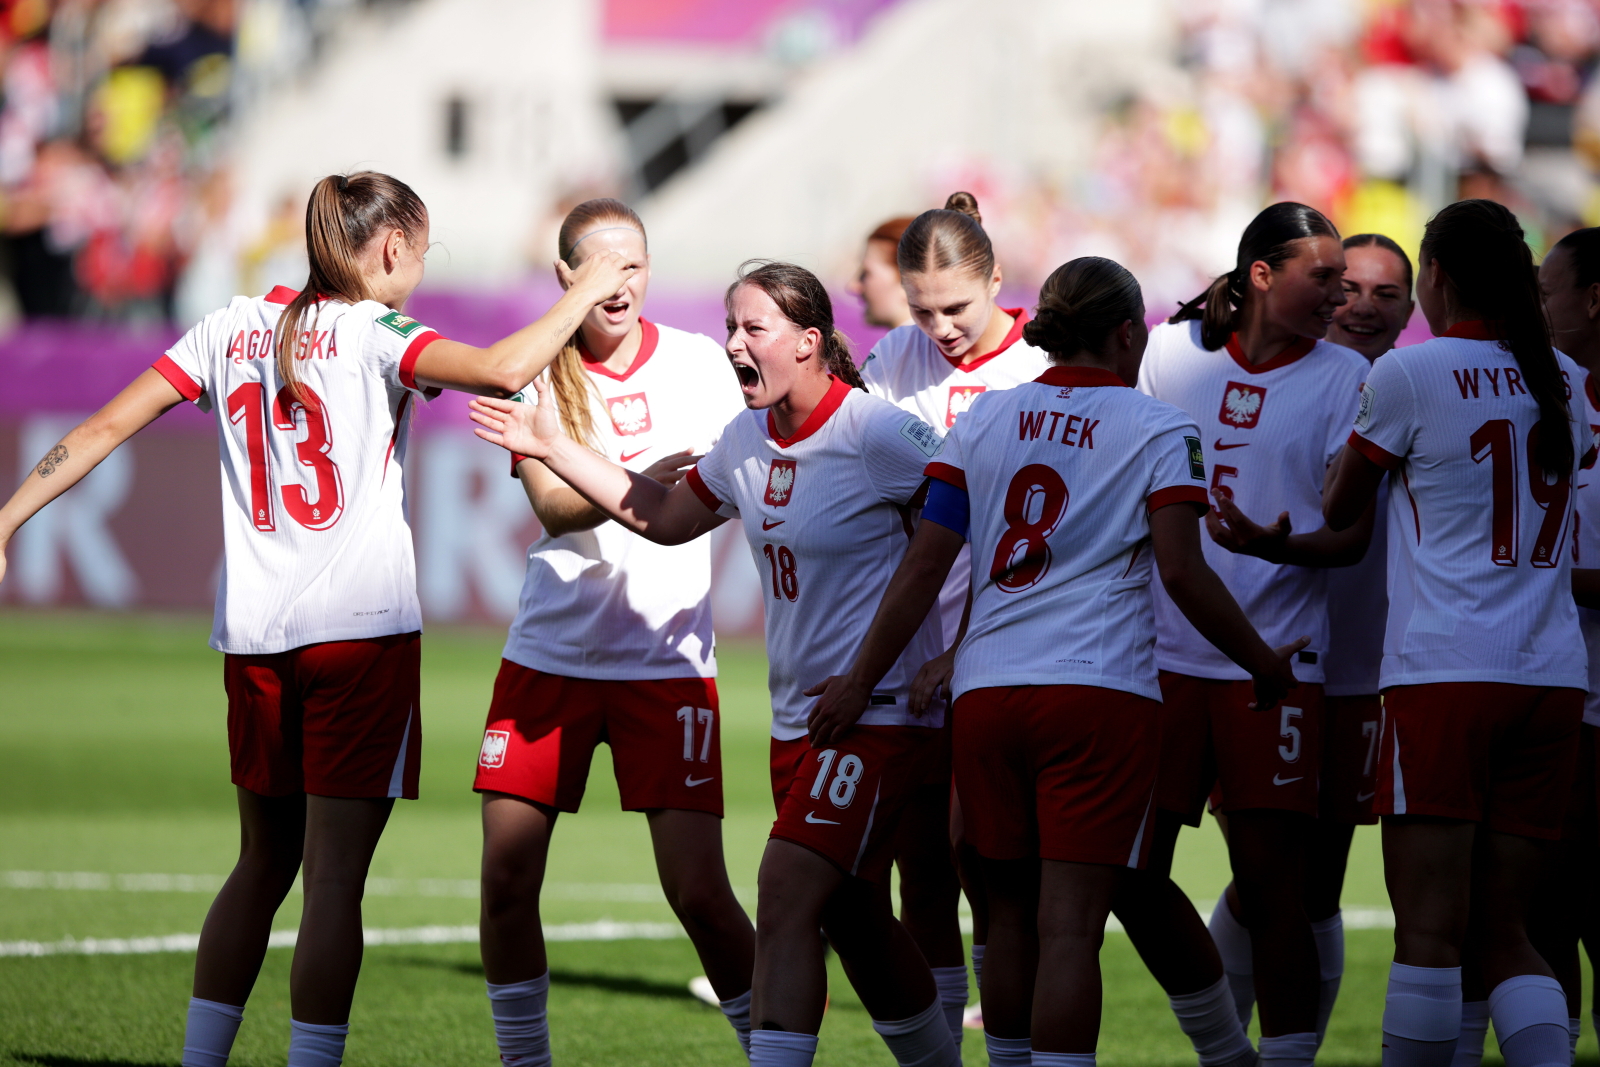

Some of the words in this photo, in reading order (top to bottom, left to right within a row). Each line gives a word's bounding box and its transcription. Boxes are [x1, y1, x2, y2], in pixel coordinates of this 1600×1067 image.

[227, 381, 344, 532] 13
[1469, 418, 1573, 569] 19
[989, 463, 1070, 594] 8
[763, 543, 799, 603] 18
[676, 705, 714, 764] 17
[1278, 705, 1304, 765] 5
[809, 748, 865, 810] 18
